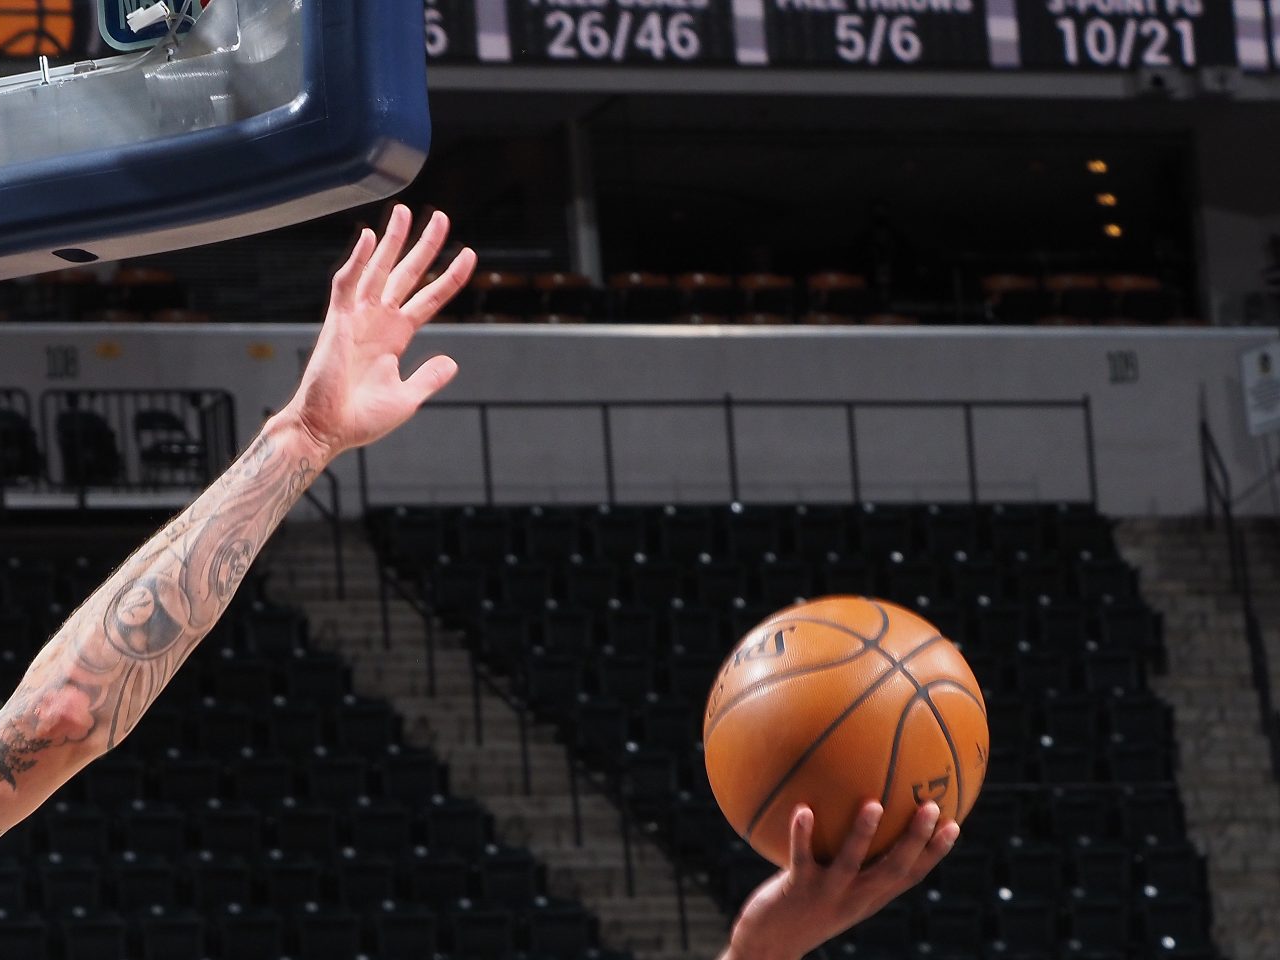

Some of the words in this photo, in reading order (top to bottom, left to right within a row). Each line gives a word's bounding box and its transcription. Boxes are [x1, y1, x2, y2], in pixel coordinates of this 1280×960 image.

[545, 10, 700, 60] 26/46
[835, 14, 922, 64] 5/6
[1055, 17, 1196, 66] 10/21
